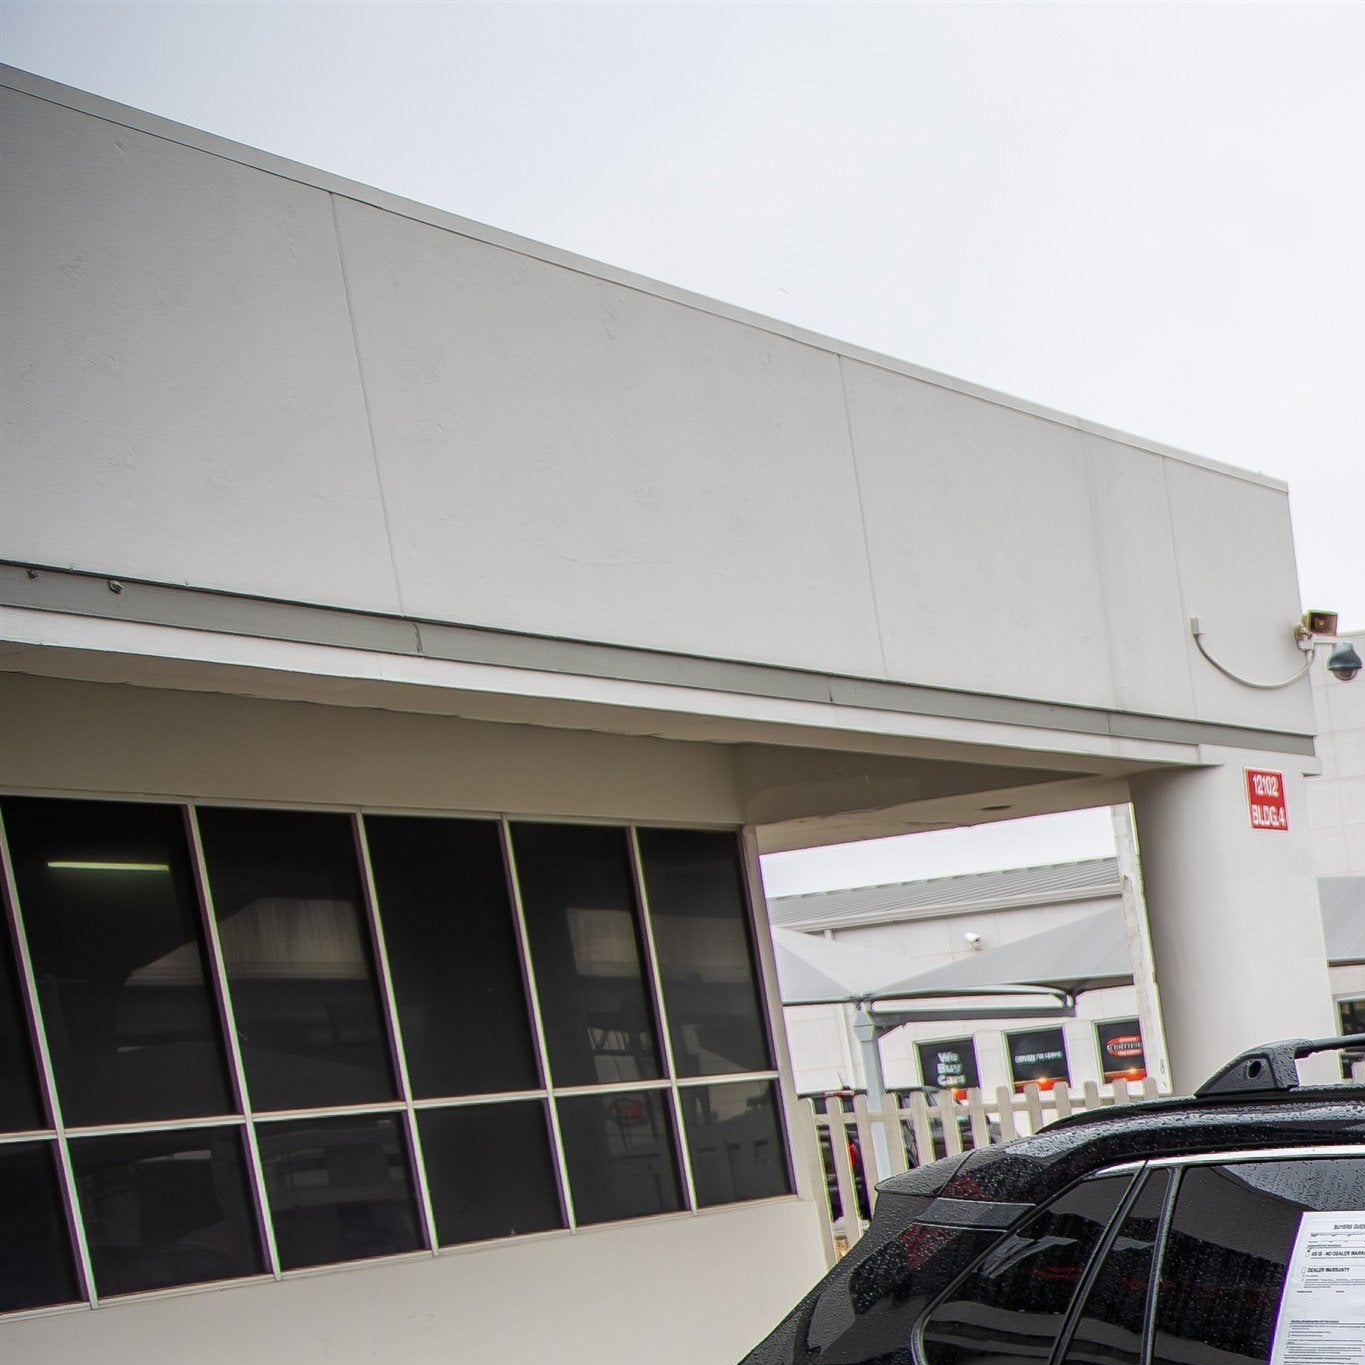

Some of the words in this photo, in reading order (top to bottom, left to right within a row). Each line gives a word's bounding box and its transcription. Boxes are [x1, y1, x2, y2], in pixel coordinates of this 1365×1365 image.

[1252, 774, 1279, 797] 12102
[937, 1052, 959, 1063] We
[937, 1062, 963, 1075] Buy
